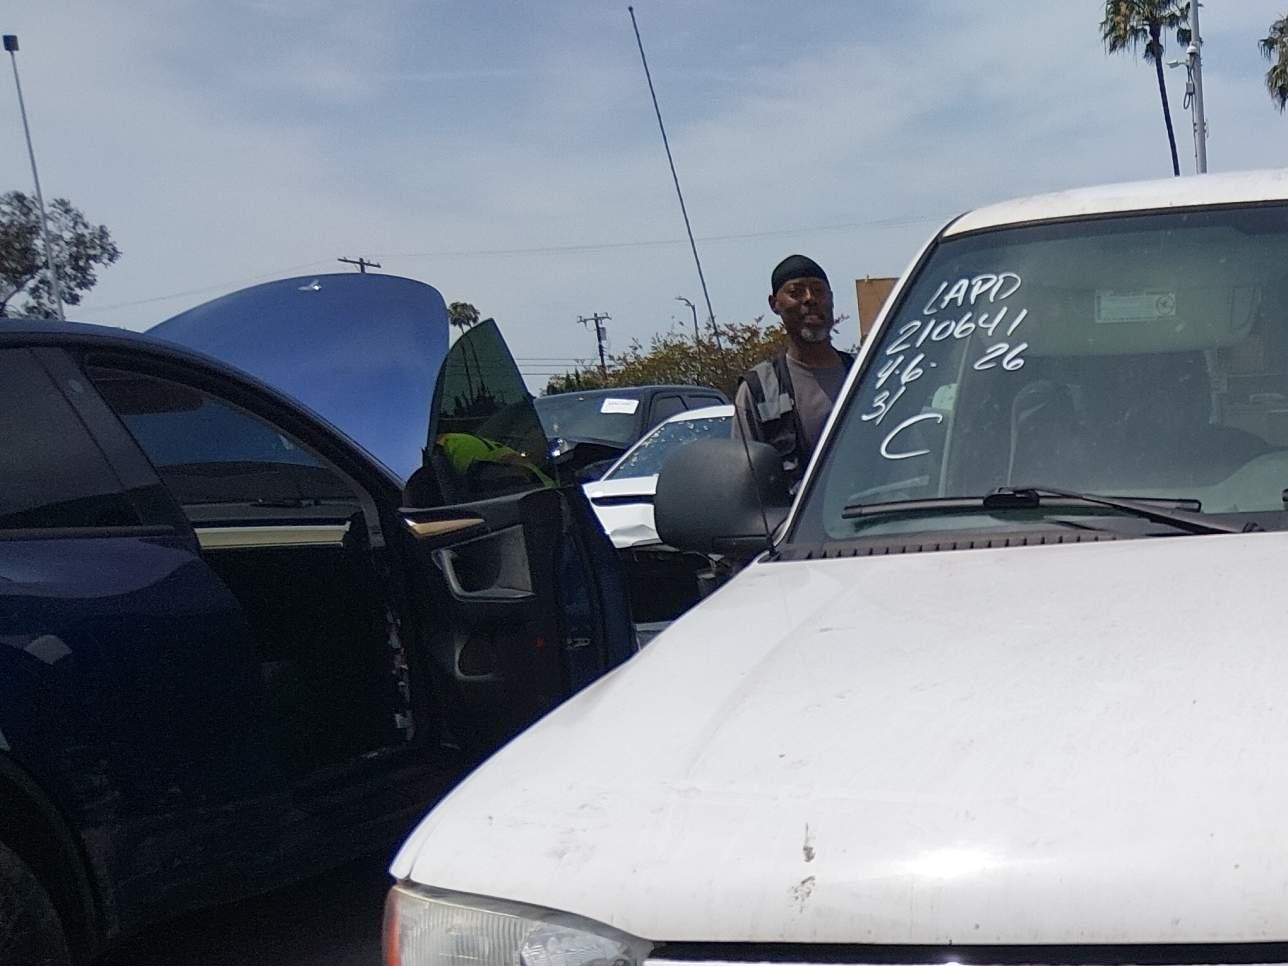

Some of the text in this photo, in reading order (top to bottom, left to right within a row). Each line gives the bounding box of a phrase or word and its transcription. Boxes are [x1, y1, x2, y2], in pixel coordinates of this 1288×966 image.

[923, 272, 1022, 315] LAPD
[886, 306, 1028, 355] 210641
[973, 342, 1029, 371] 26
[880, 413, 943, 459] C
